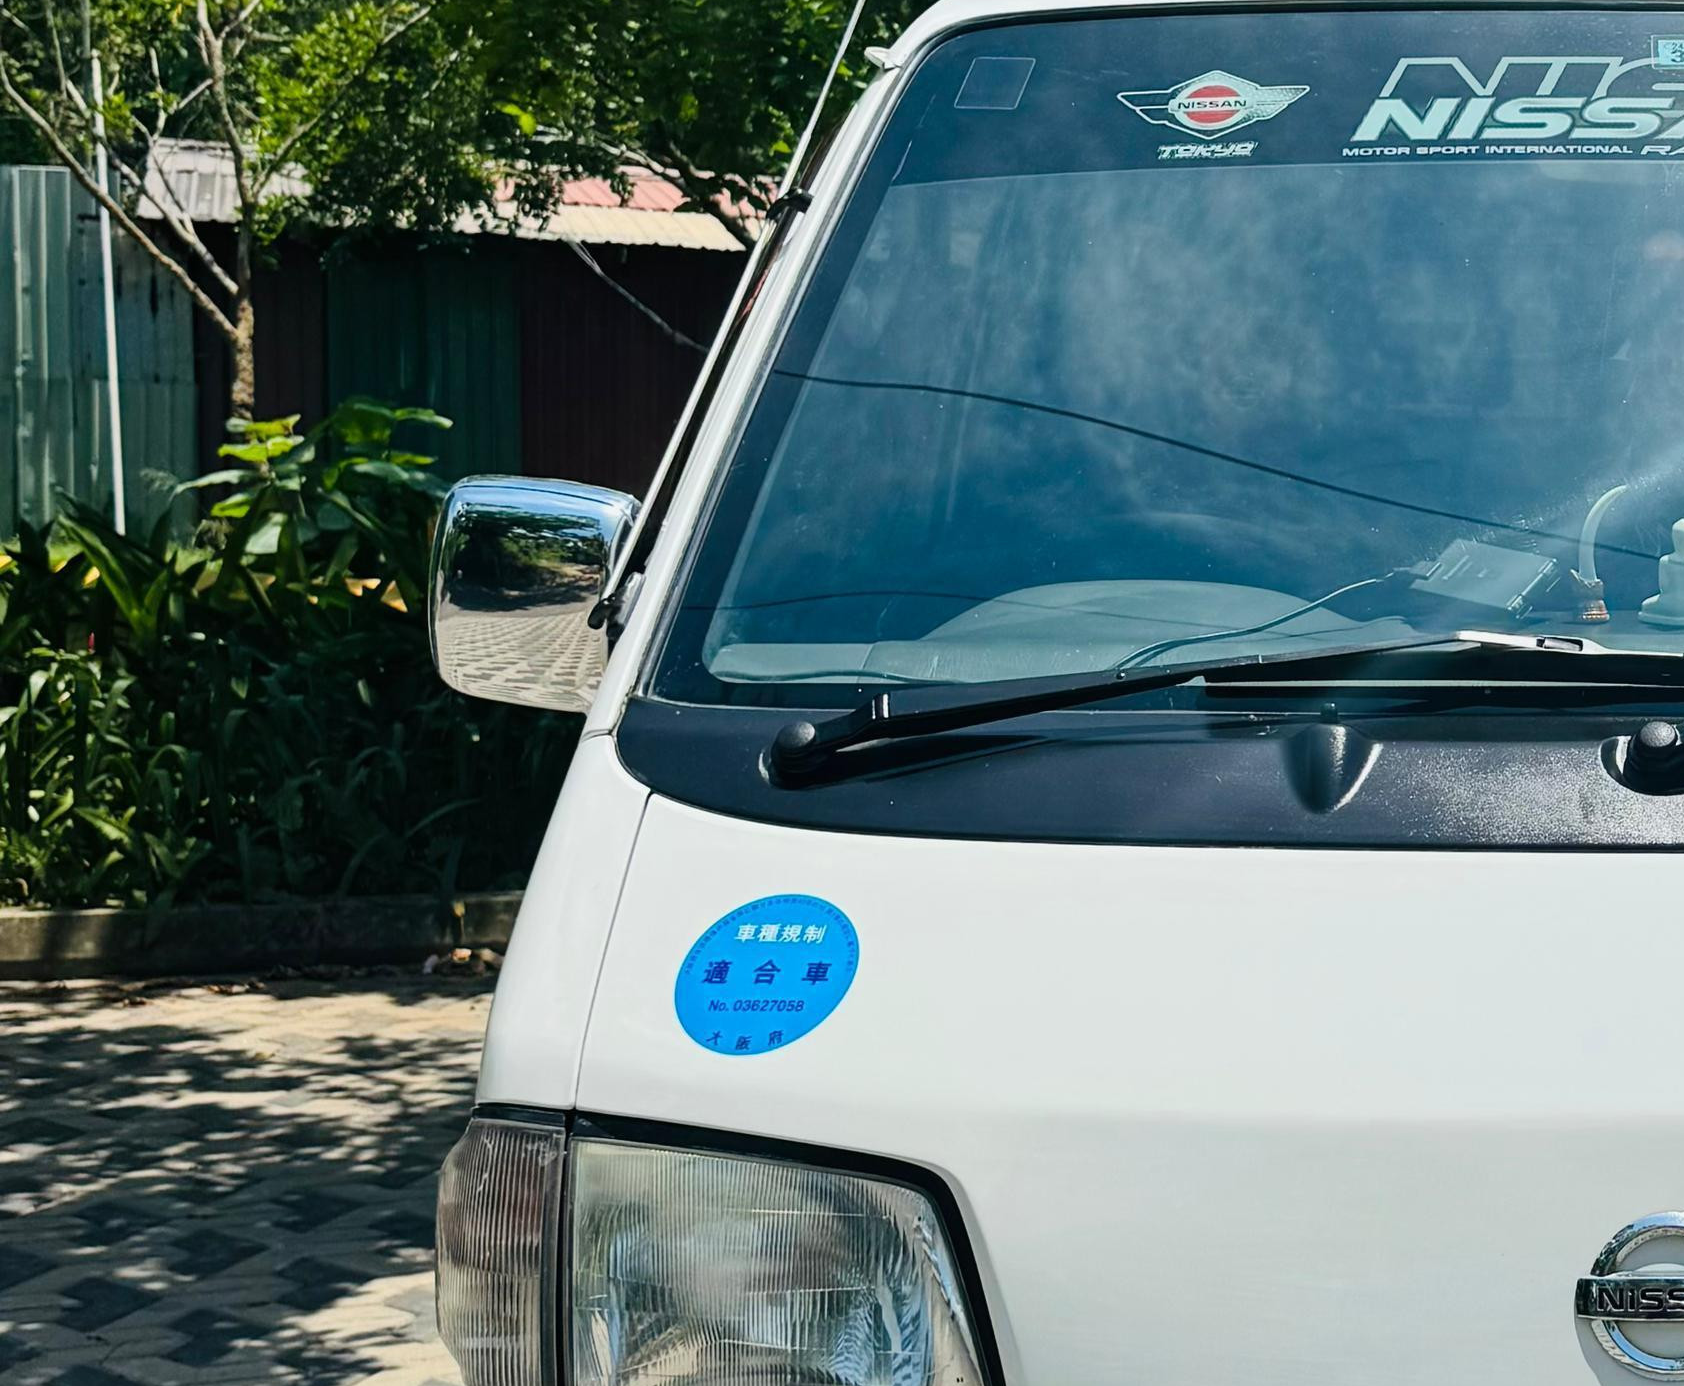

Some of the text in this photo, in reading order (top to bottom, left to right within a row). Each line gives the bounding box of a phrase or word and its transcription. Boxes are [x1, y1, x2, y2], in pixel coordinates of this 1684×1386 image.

[1671, 50, 1684, 63] 3
[1177, 100, 1248, 110] NISSAN
[1157, 141, 1259, 160] TOKYO
[1342, 146, 1410, 157] MOTOR
[1416, 145, 1480, 155] SPORT
[1485, 144, 1633, 155] INTERNATIONAL
[735, 923, 828, 945] 車種規制
[708, 999, 805, 1013] No. 03627058
